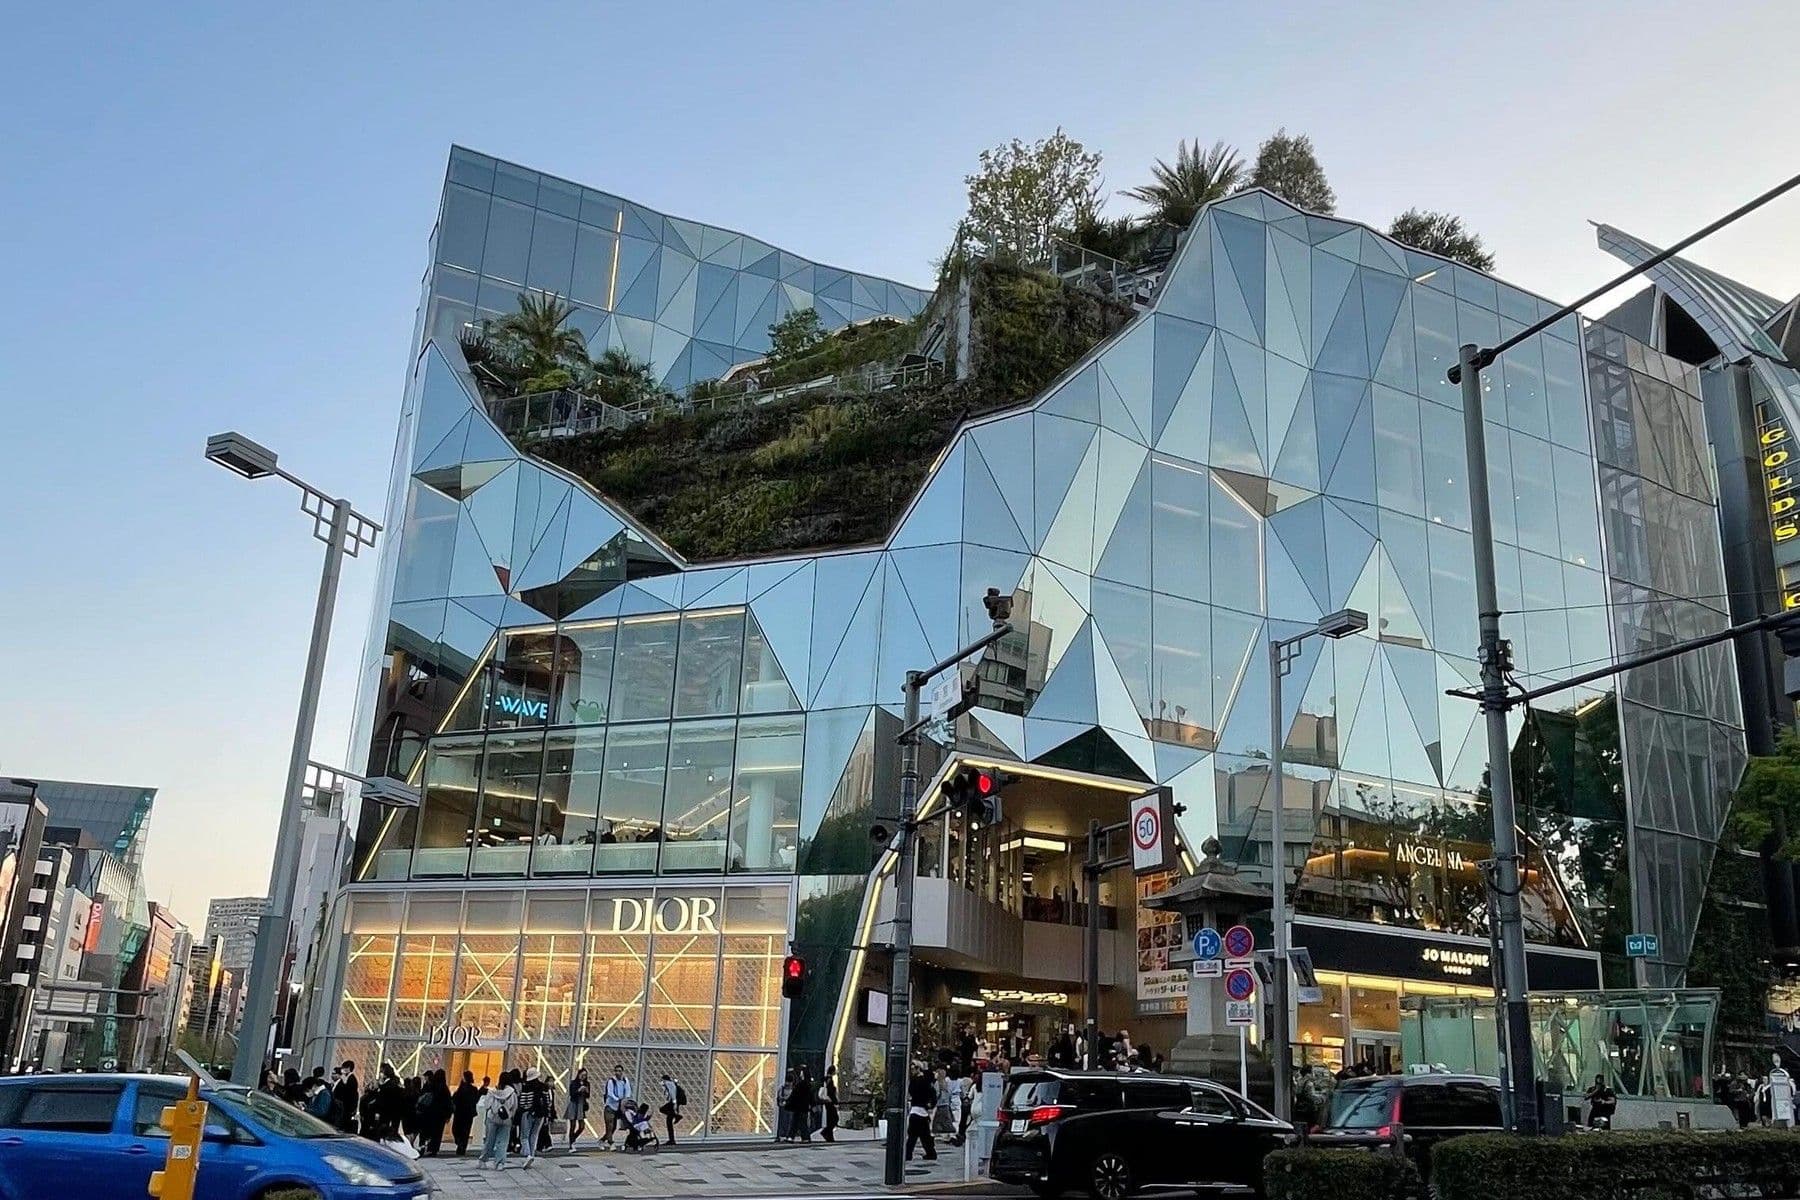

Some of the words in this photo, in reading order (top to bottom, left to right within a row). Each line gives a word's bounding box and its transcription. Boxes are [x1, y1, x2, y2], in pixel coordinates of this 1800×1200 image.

[1139, 818, 1154, 838] 50
[1396, 843, 1464, 871] ANGELNA
[612, 897, 719, 934] DIOR
[1422, 948, 1439, 961] JO
[1440, 950, 1489, 967] MALONE
[429, 1025, 482, 1046] DIOR
